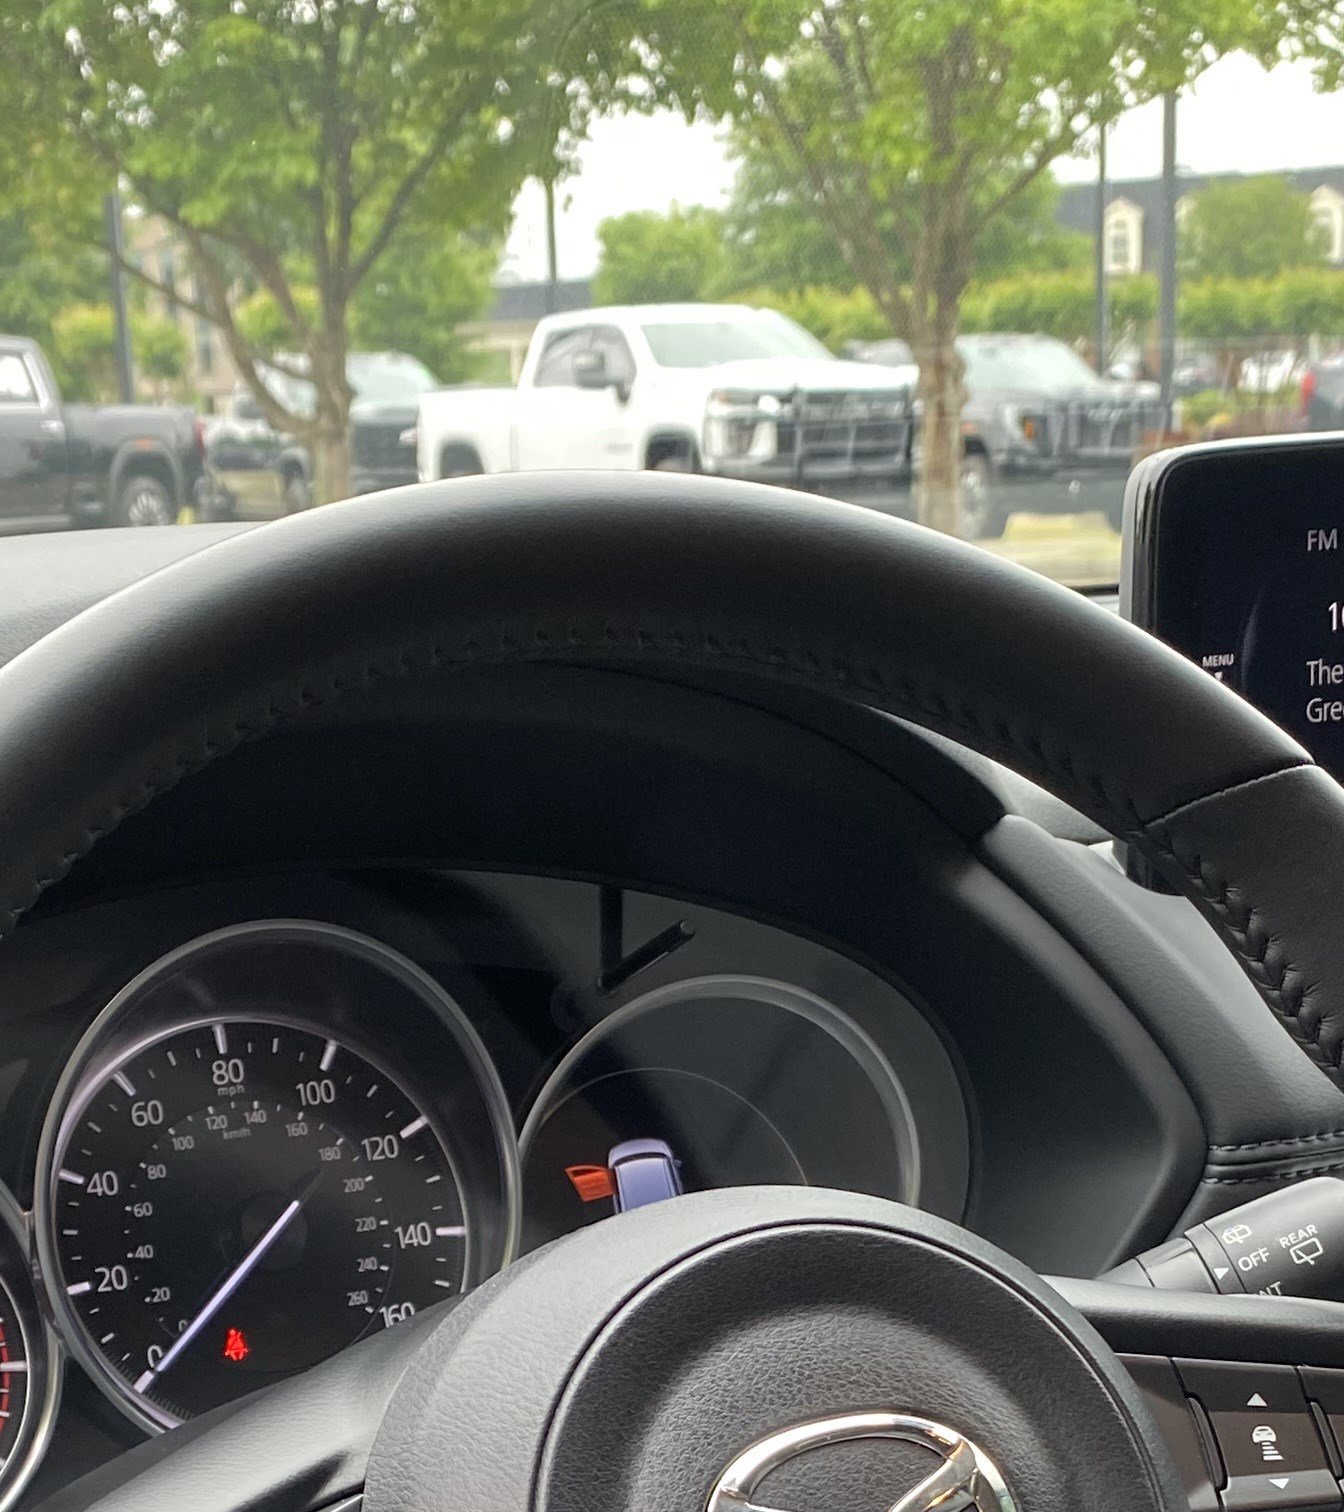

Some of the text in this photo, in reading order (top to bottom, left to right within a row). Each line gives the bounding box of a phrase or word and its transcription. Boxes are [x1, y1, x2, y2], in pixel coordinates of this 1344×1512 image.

[1307, 528, 1338, 551] FM
[1202, 653, 1234, 667] MENU
[1306, 659, 1343, 686] The
[212, 1058, 245, 1085] 80
[217, 1084, 245, 1097] mph
[295, 1079, 335, 1106] 100
[131, 1100, 164, 1127] 60
[243, 1109, 267, 1125] 140
[205, 1115, 228, 1131] 120
[285, 1122, 307, 1138] 160
[172, 1136, 195, 1151] 100
[361, 1134, 399, 1162] 120
[319, 1147, 341, 1162] 180
[147, 1164, 167, 1180] 80
[86, 1170, 119, 1197] 40
[342, 1177, 365, 1193] 200
[133, 1202, 153, 1218] 60
[355, 1216, 377, 1232] 220
[394, 1221, 432, 1249] 140
[1279, 1224, 1319, 1248] REAR
[134, 1244, 154, 1259] 40
[1238, 1247, 1270, 1272] OFF
[357, 1257, 378, 1272] 240
[95, 1264, 128, 1292] 20
[151, 1287, 171, 1303] 20
[379, 1302, 416, 1328] 160
